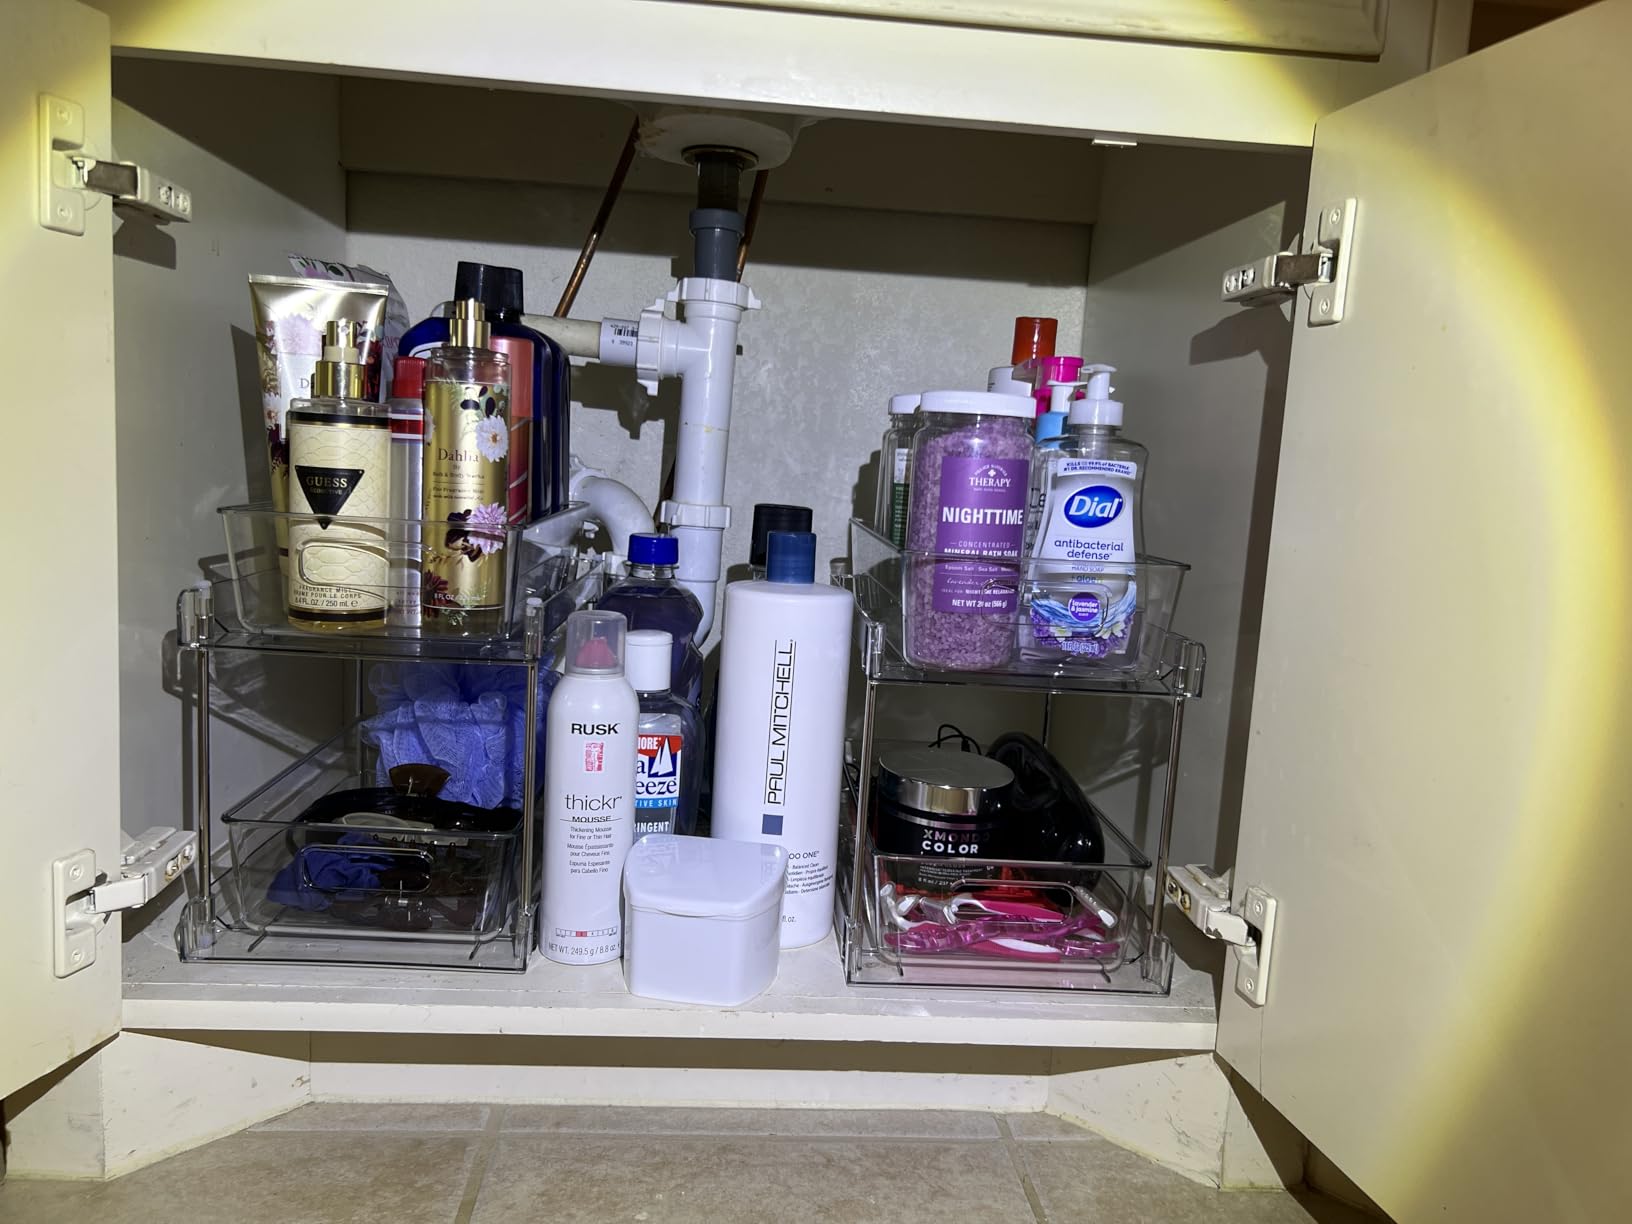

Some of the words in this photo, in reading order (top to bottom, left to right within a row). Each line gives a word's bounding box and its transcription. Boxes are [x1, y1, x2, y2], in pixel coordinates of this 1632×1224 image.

[438, 448, 479, 462] Dahlia
[305, 476, 348, 488] GUESS
[969, 477, 1012, 487] THERAPY
[1068, 495, 1120, 518] Dial
[942, 506, 1024, 525] NIGHTTIME
[958, 541, 1011, 549] CONCENTRATED
[1054, 539, 1124, 552] antibacterial
[1067, 549, 1110, 560] defense
[772, 639, 793, 746] MITCHELL
[571, 723, 619, 736] RUSK
[638, 737, 661, 750] ORE
[767, 750, 785, 804] PAUL
[635, 779, 677, 796] eeze
[564, 794, 623, 811] thickr
[658, 800, 677, 808] SKIN
[571, 815, 611, 823] MOUSSE
[922, 840, 979, 854] COLOR
[802, 851, 818, 859] ONE
[570, 946, 589, 956] 249.5
